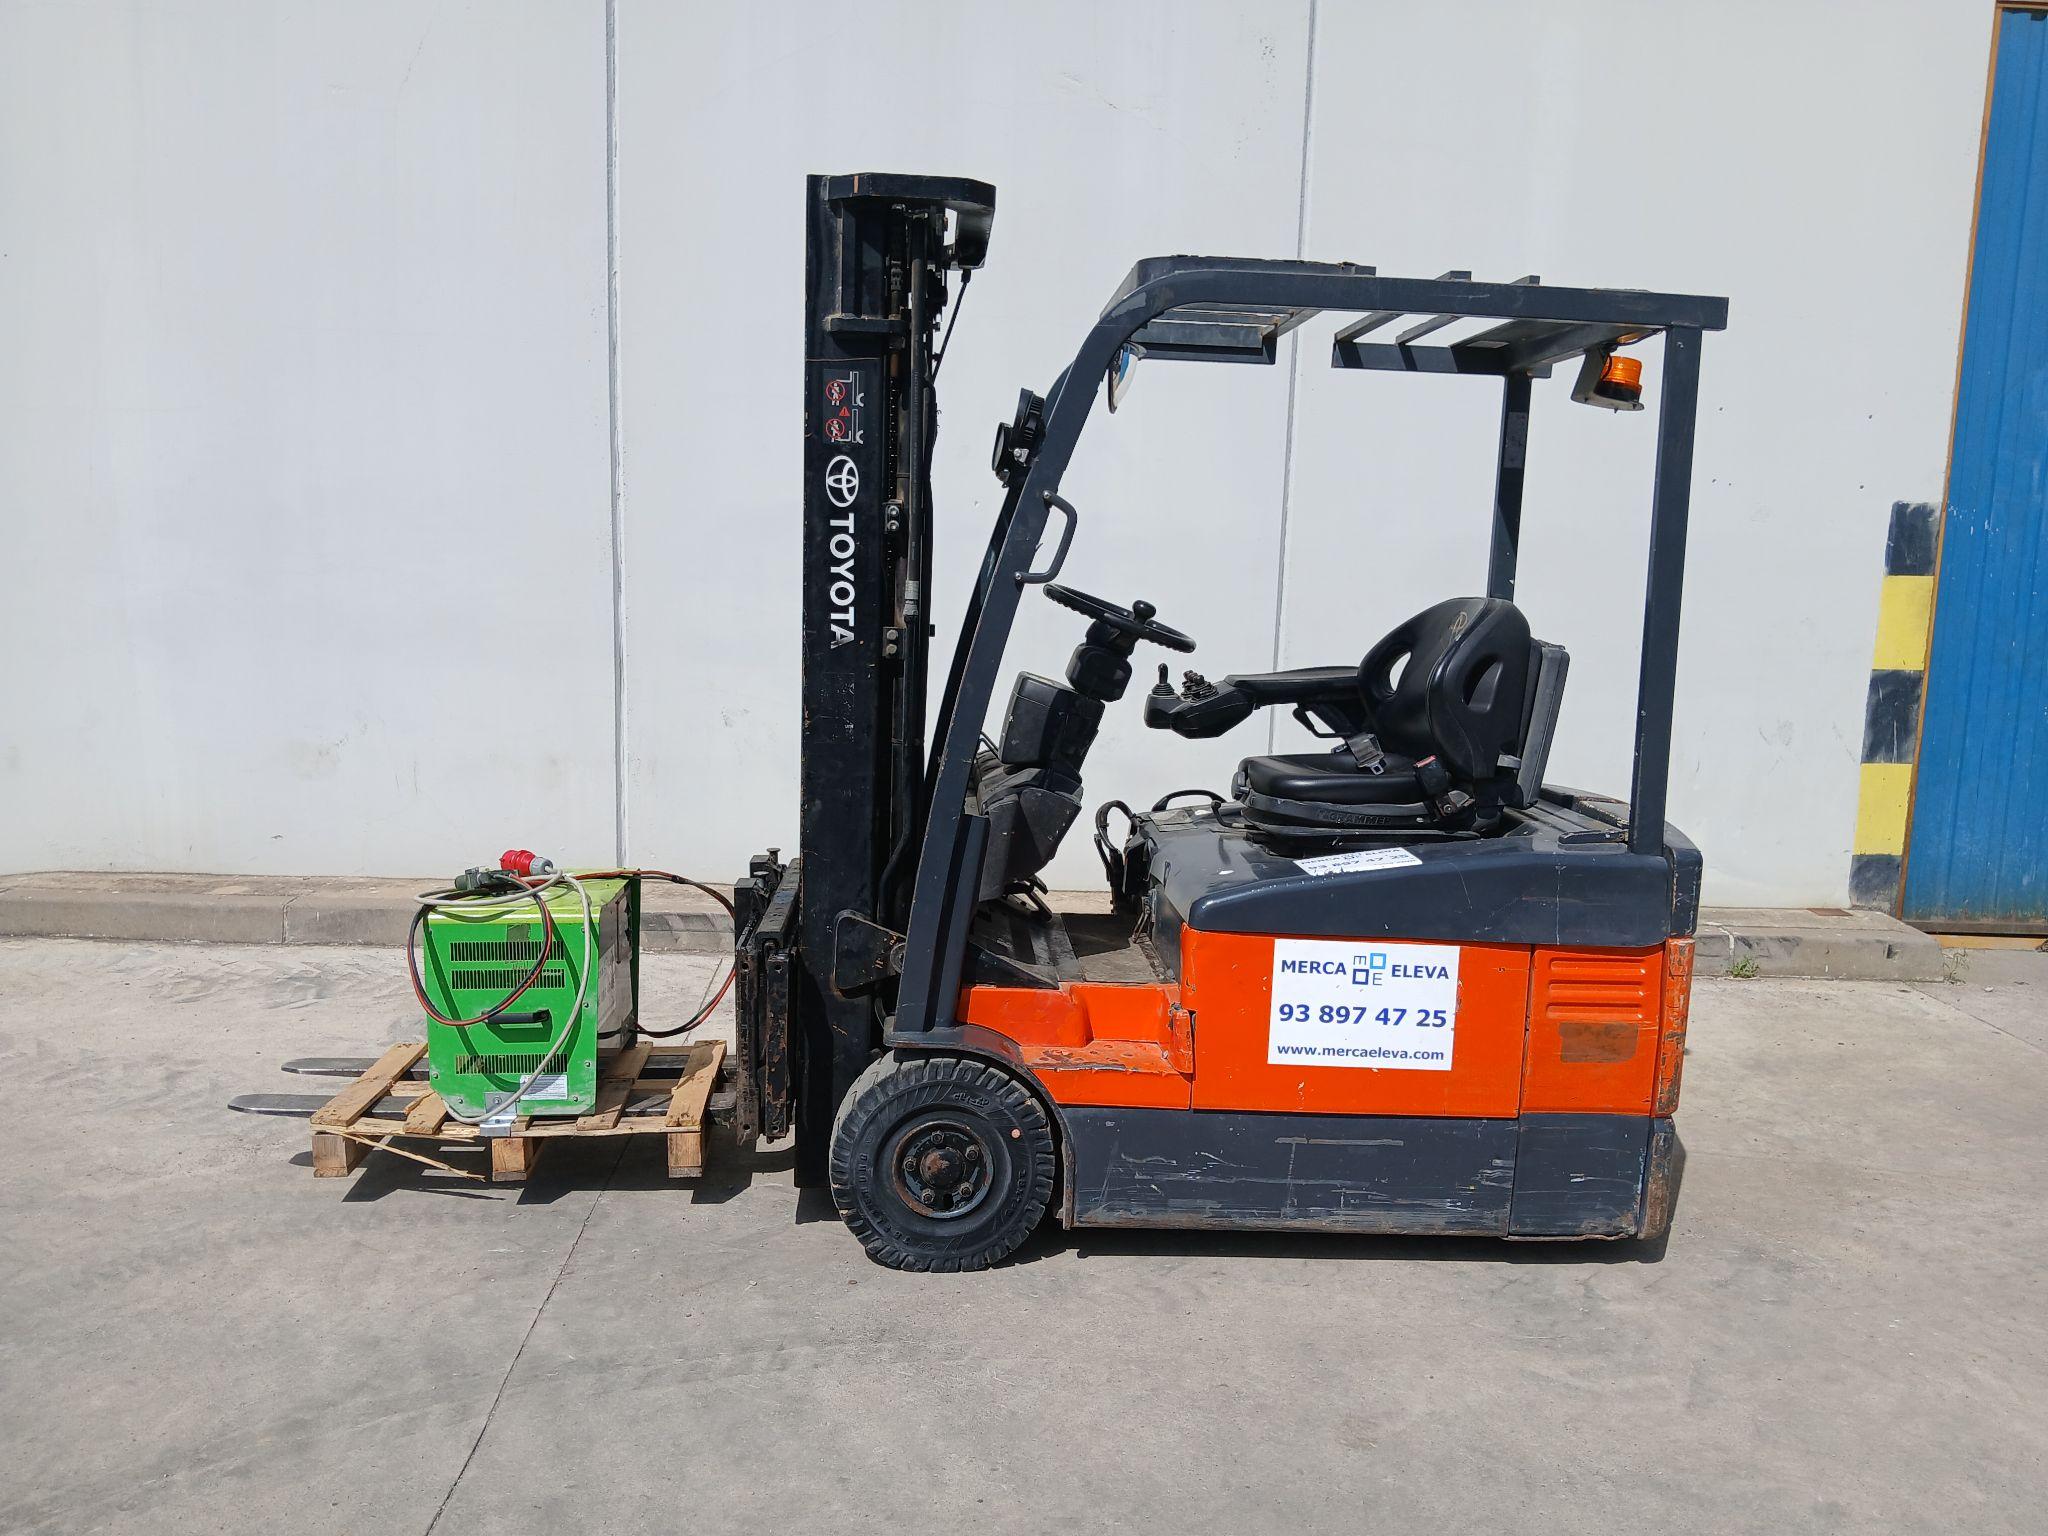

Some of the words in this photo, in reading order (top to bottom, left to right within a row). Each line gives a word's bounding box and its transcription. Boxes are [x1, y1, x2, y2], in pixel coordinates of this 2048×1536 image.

[829, 513, 856, 650] TOYOTA
[1281, 959, 1347, 975] MERCA
[1391, 964, 1450, 980] ELEVA
[1279, 1003, 1310, 1023] 93
[1318, 1005, 1367, 1025] 897
[1374, 1007, 1407, 1026] 47
[1416, 1009, 1447, 1028] 25
[1277, 1045, 1445, 1061] www.mercaeleva.com
